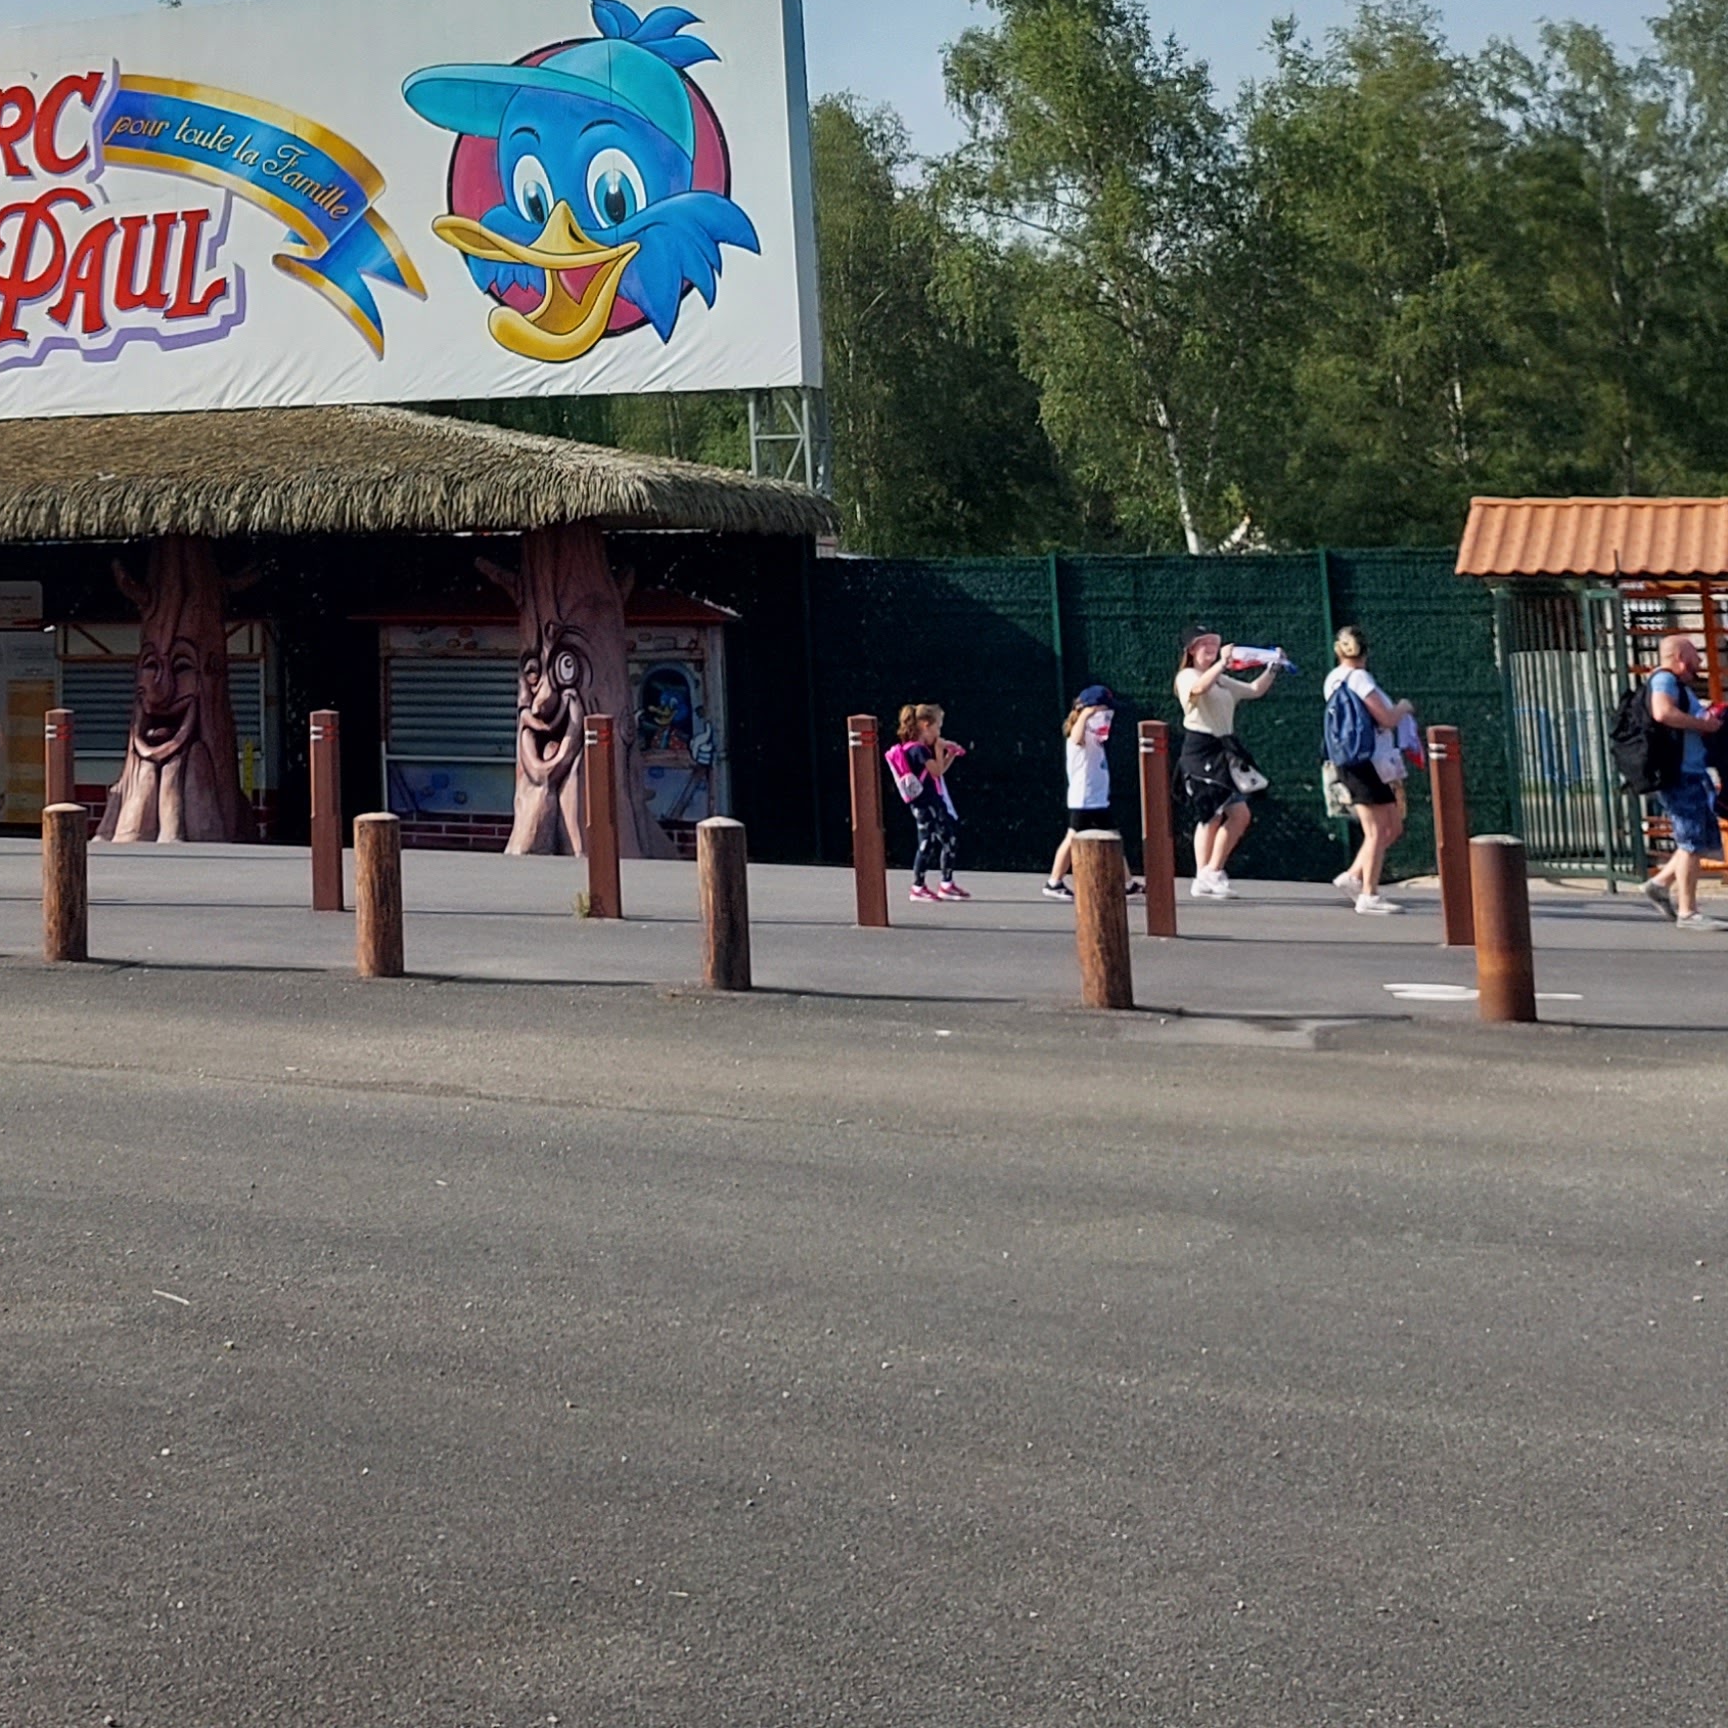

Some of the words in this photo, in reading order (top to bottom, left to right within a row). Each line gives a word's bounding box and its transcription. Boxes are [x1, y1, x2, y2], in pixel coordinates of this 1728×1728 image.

[103, 115, 171, 146] pour
[174, 115, 236, 152] toute
[232, 133, 261, 167] la
[261, 143, 350, 221] Famille
